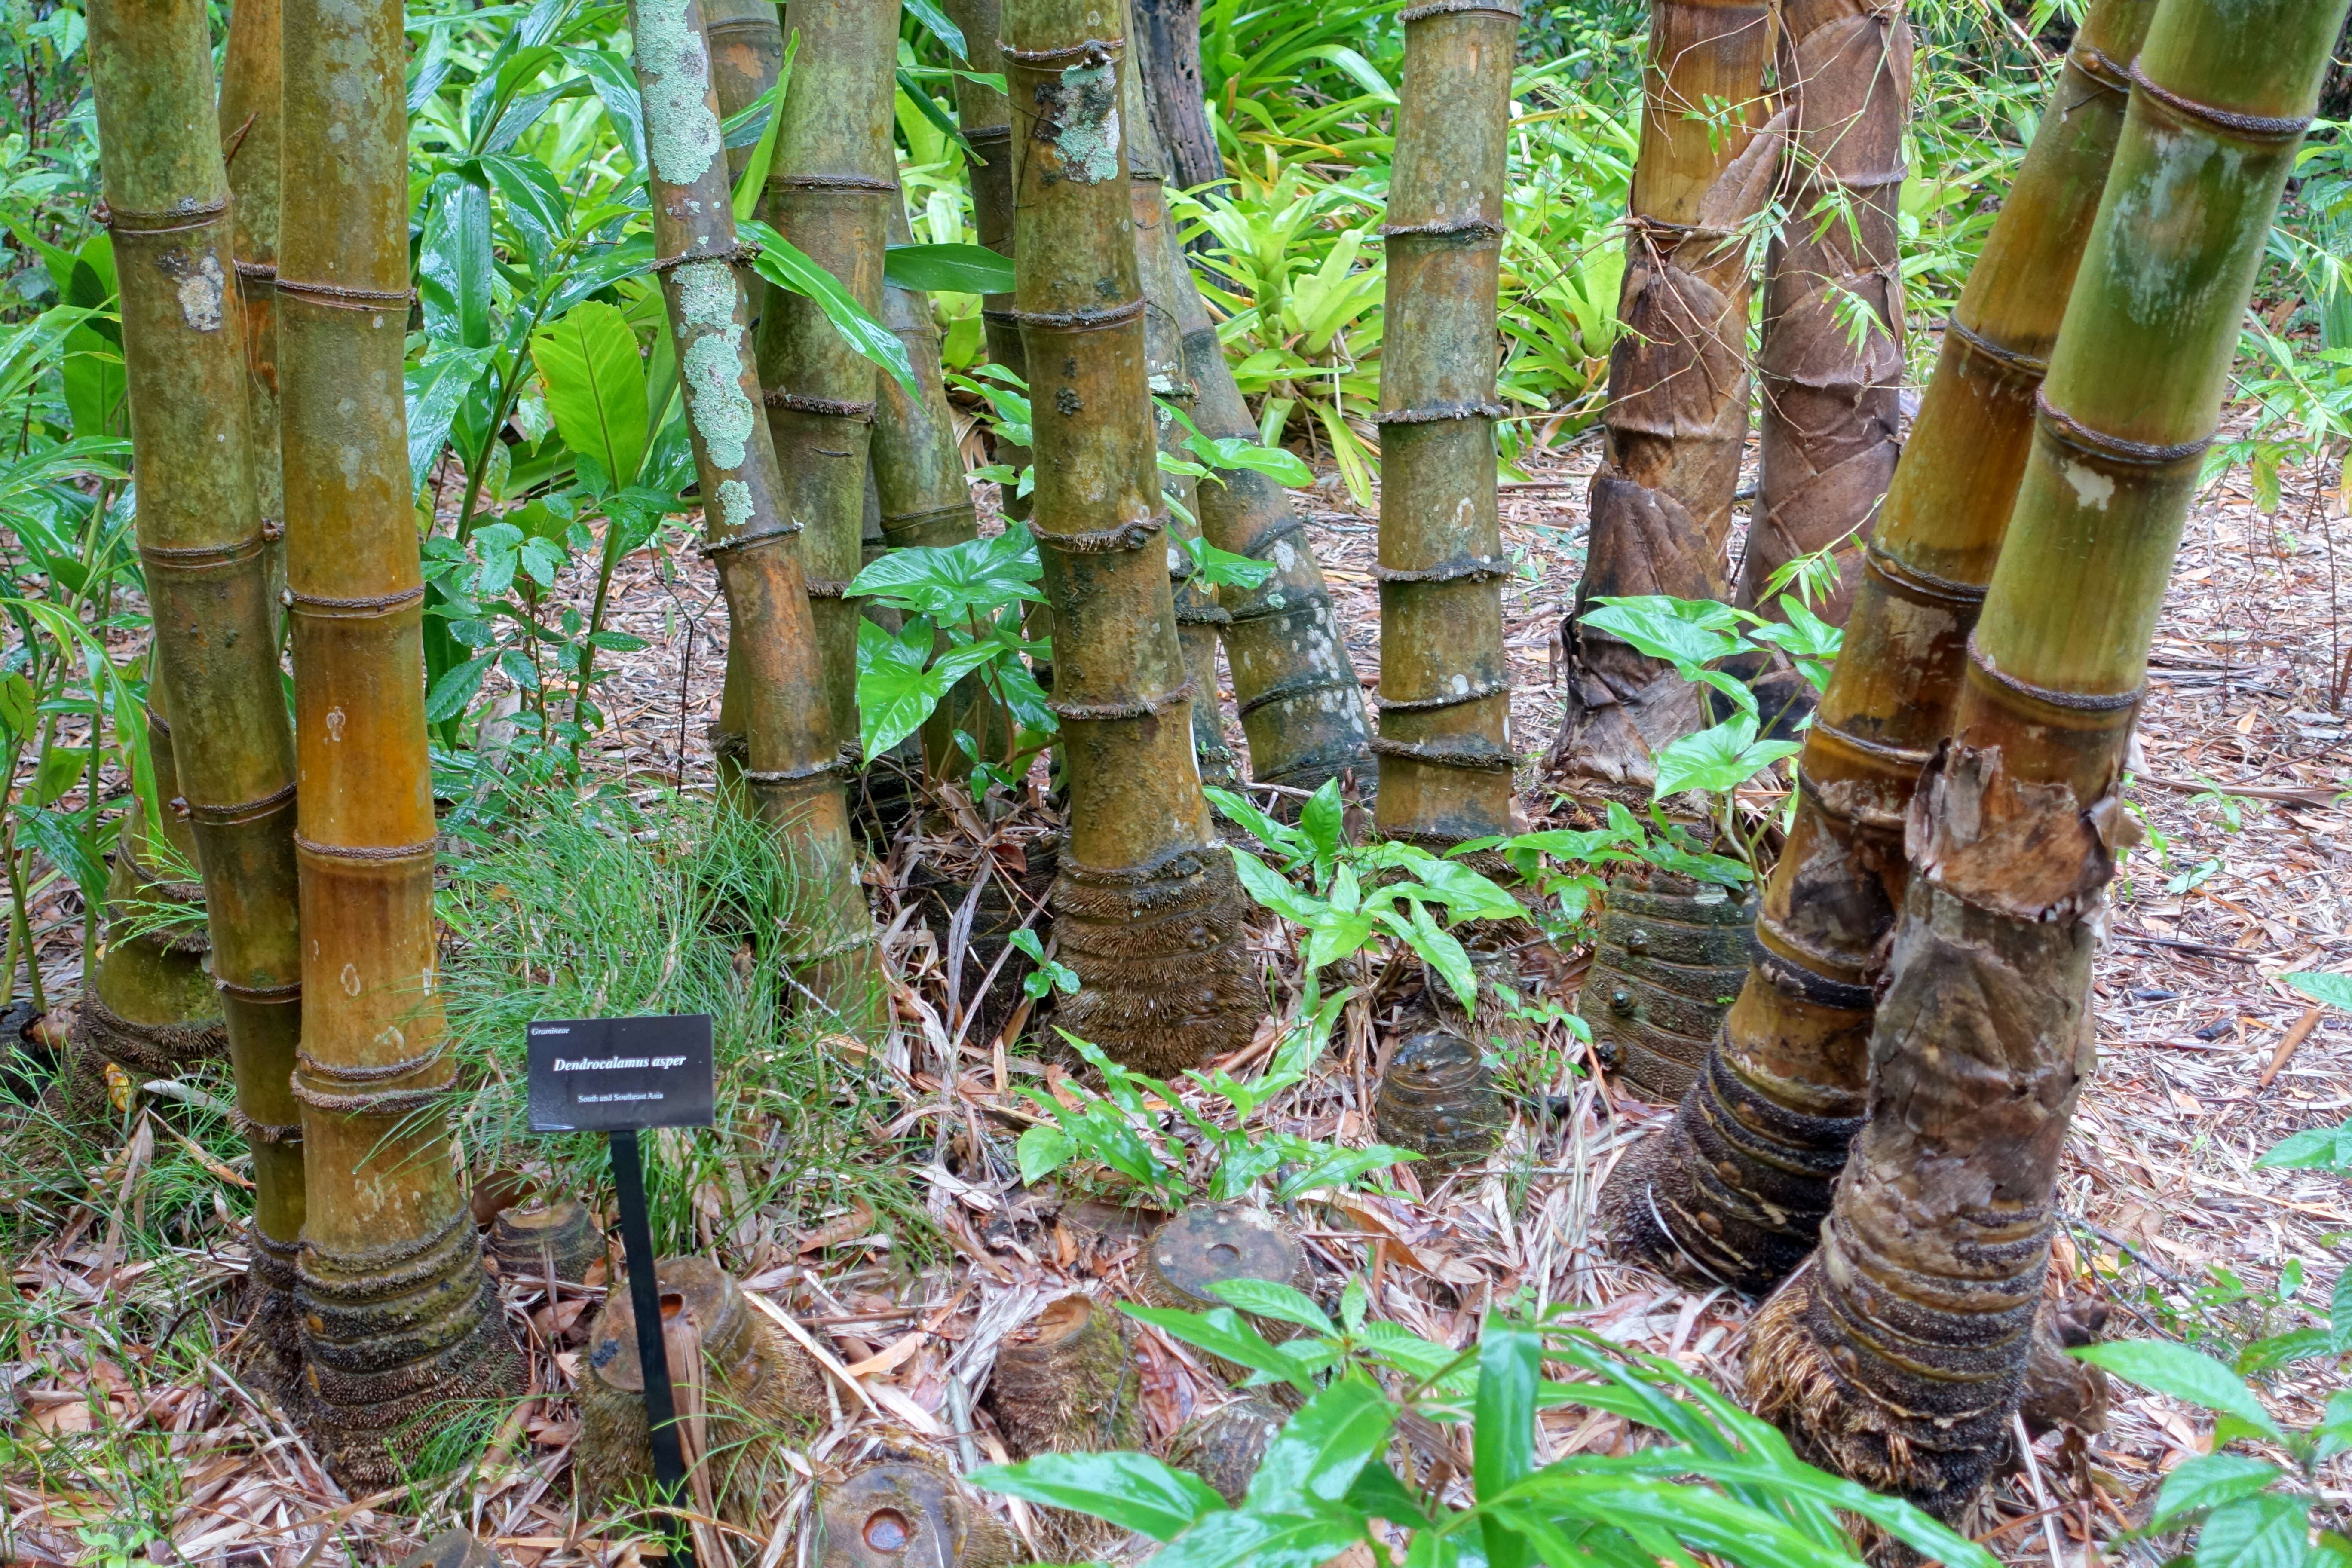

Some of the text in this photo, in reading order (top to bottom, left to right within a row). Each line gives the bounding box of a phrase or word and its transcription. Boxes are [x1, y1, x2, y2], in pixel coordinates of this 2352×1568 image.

[554, 1056, 686, 1071] Dendrocalamus asper
[614, 1093, 646, 1101] Southeast
[647, 1091, 663, 1100] Asia
